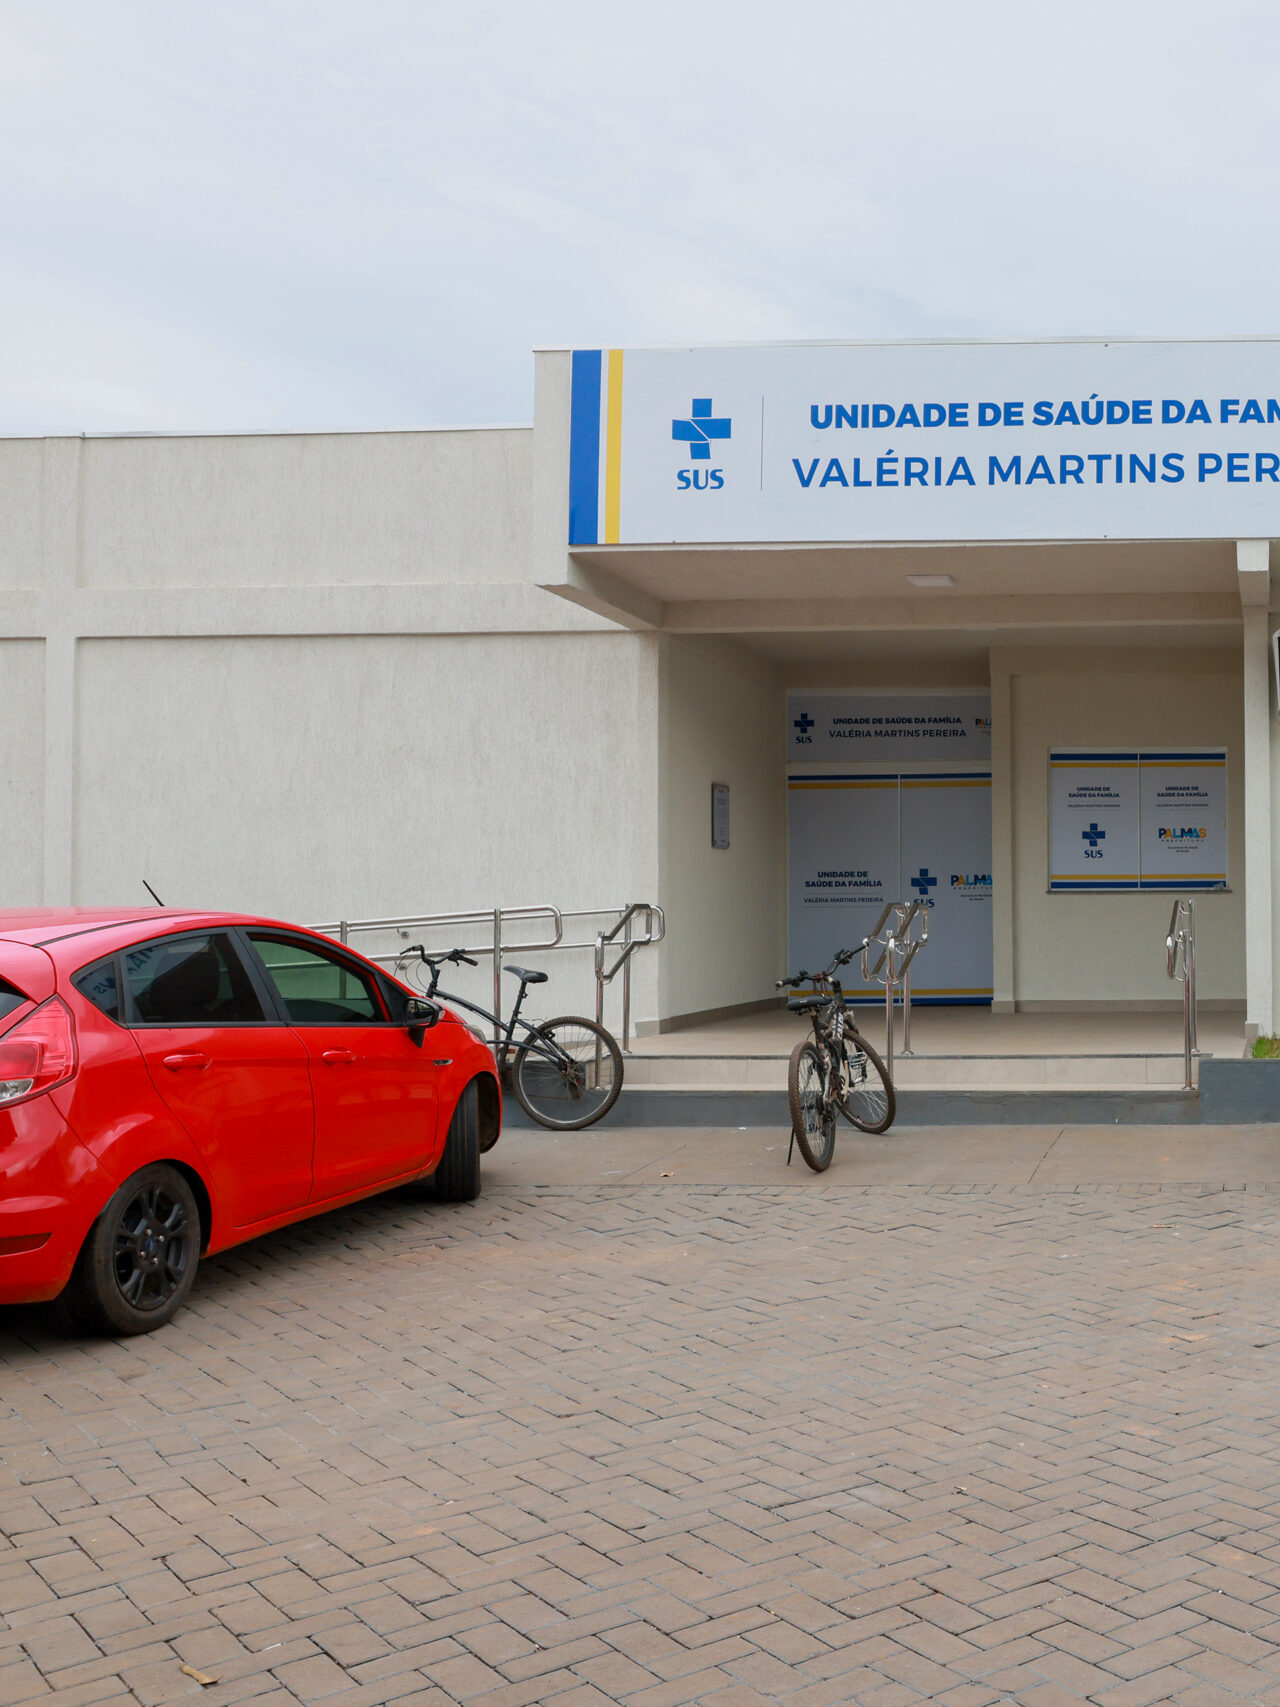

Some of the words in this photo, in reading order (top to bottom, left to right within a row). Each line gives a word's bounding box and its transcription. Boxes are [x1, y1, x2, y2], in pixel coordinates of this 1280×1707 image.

[810, 403, 968, 429] UNIDADE
[978, 402, 1023, 426] DE
[1033, 394, 1151, 425] SAÚDE
[1162, 399, 1214, 424] DA
[792, 449, 976, 488] VALÉRIA
[989, 453, 1184, 486] MARTINS
[677, 469, 724, 490] SUS
[885, 716, 912, 724] SAÚDE
[928, 716, 961, 724] FAMÍLIA
[830, 728, 872, 738] VALÉRIA
[1158, 828, 1207, 838] PALMAS
[1084, 850, 1103, 858] SUS
[848, 879, 882, 887] FAMÍLIA
[951, 875, 992, 886] PALMA
